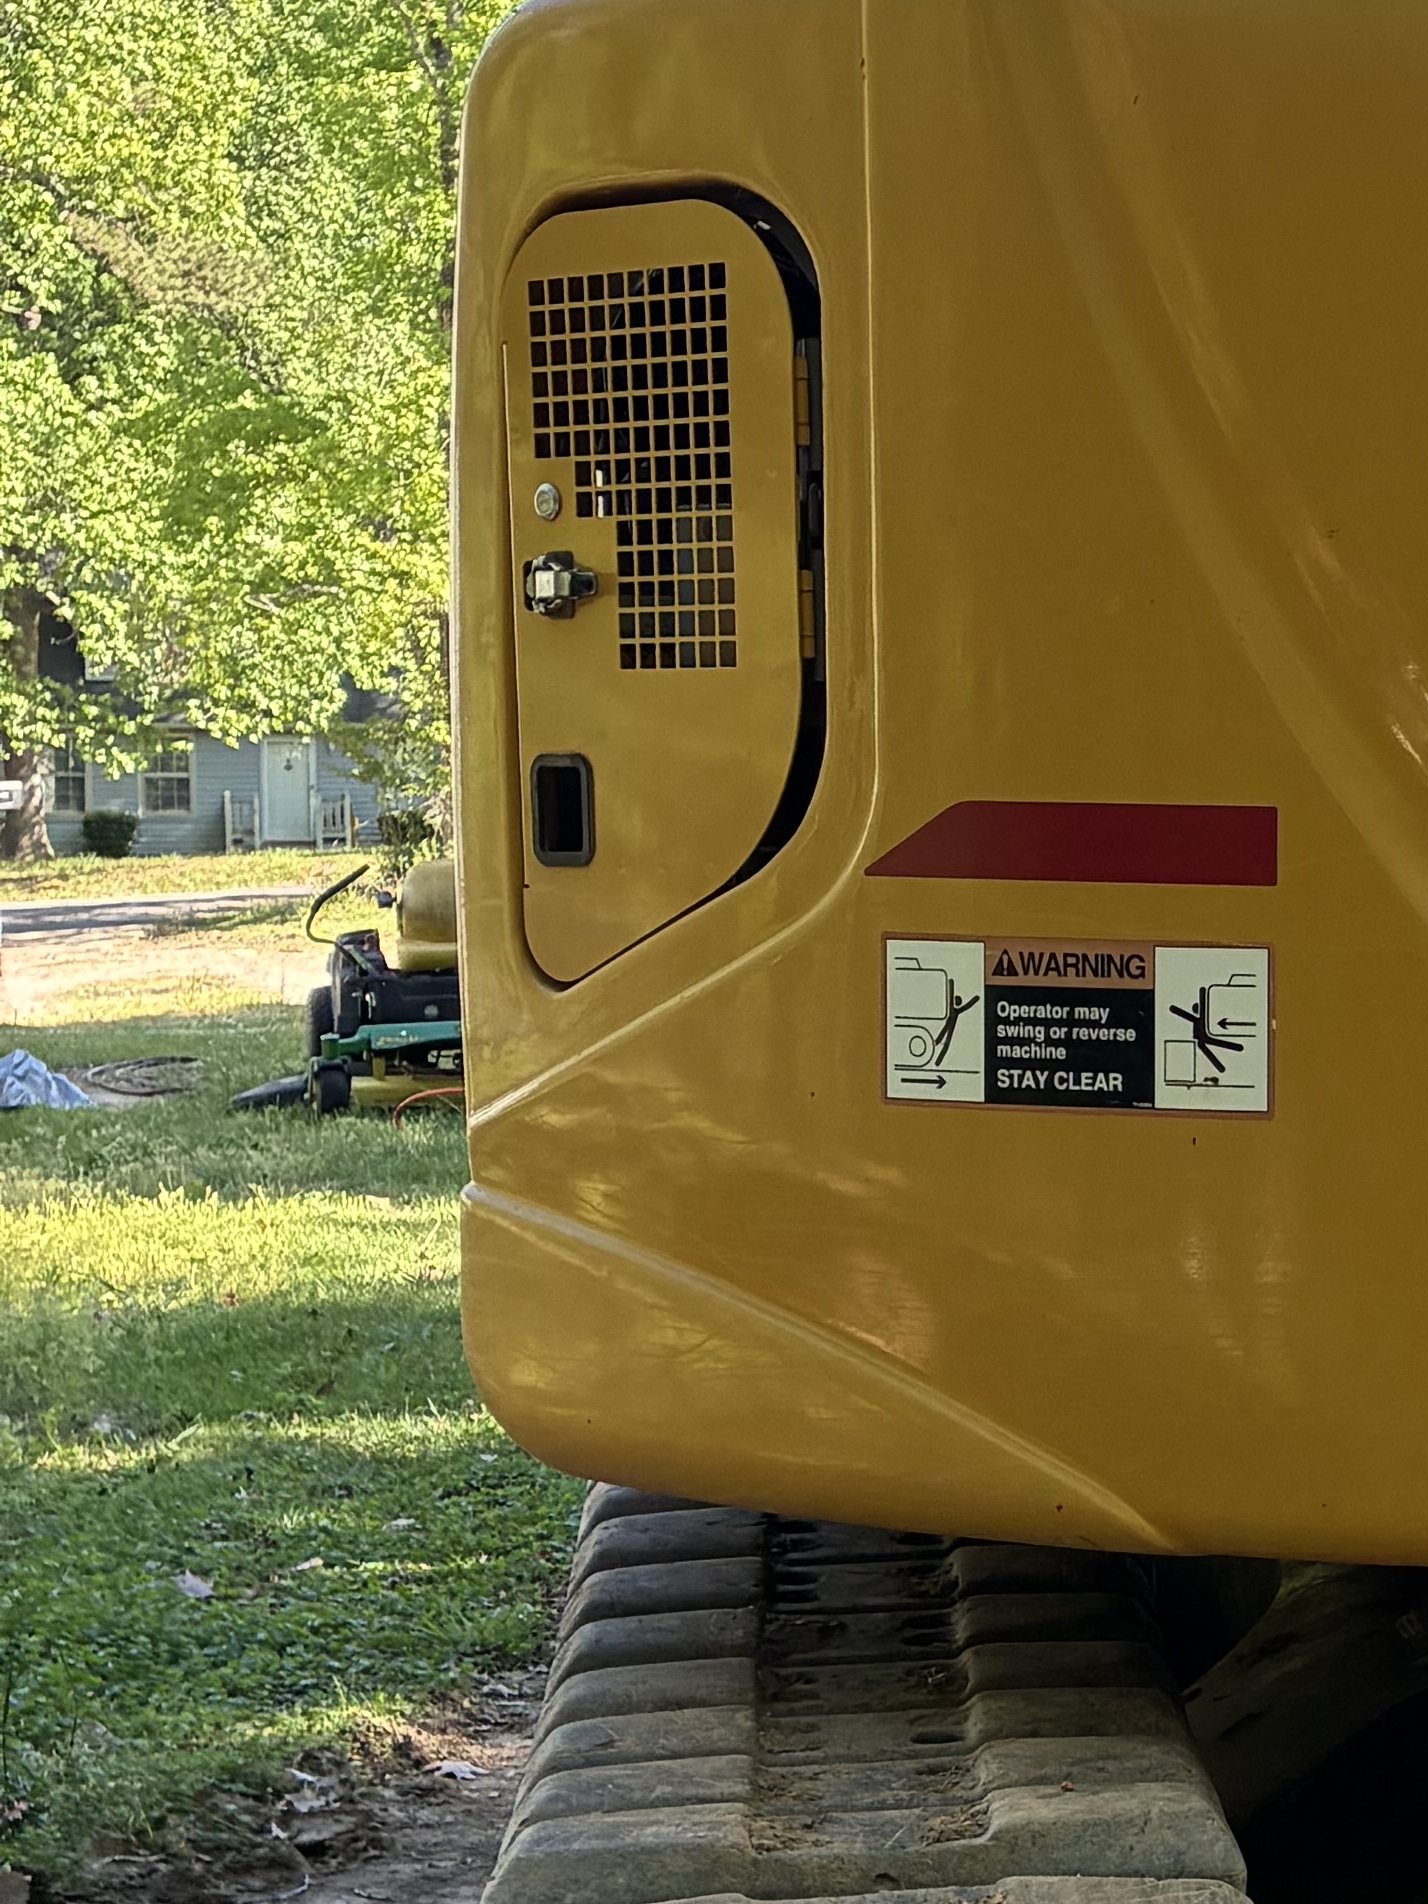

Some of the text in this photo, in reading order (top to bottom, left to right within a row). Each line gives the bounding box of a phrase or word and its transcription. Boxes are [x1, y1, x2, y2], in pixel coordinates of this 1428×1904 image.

[1018, 951, 1146, 980] WARNING
[996, 1000, 1110, 1025] Operator may
[996, 1022, 1136, 1042] swing or reverse
[996, 1042, 1067, 1060] machine
[996, 1068, 1123, 1092] STAY CLEAR
